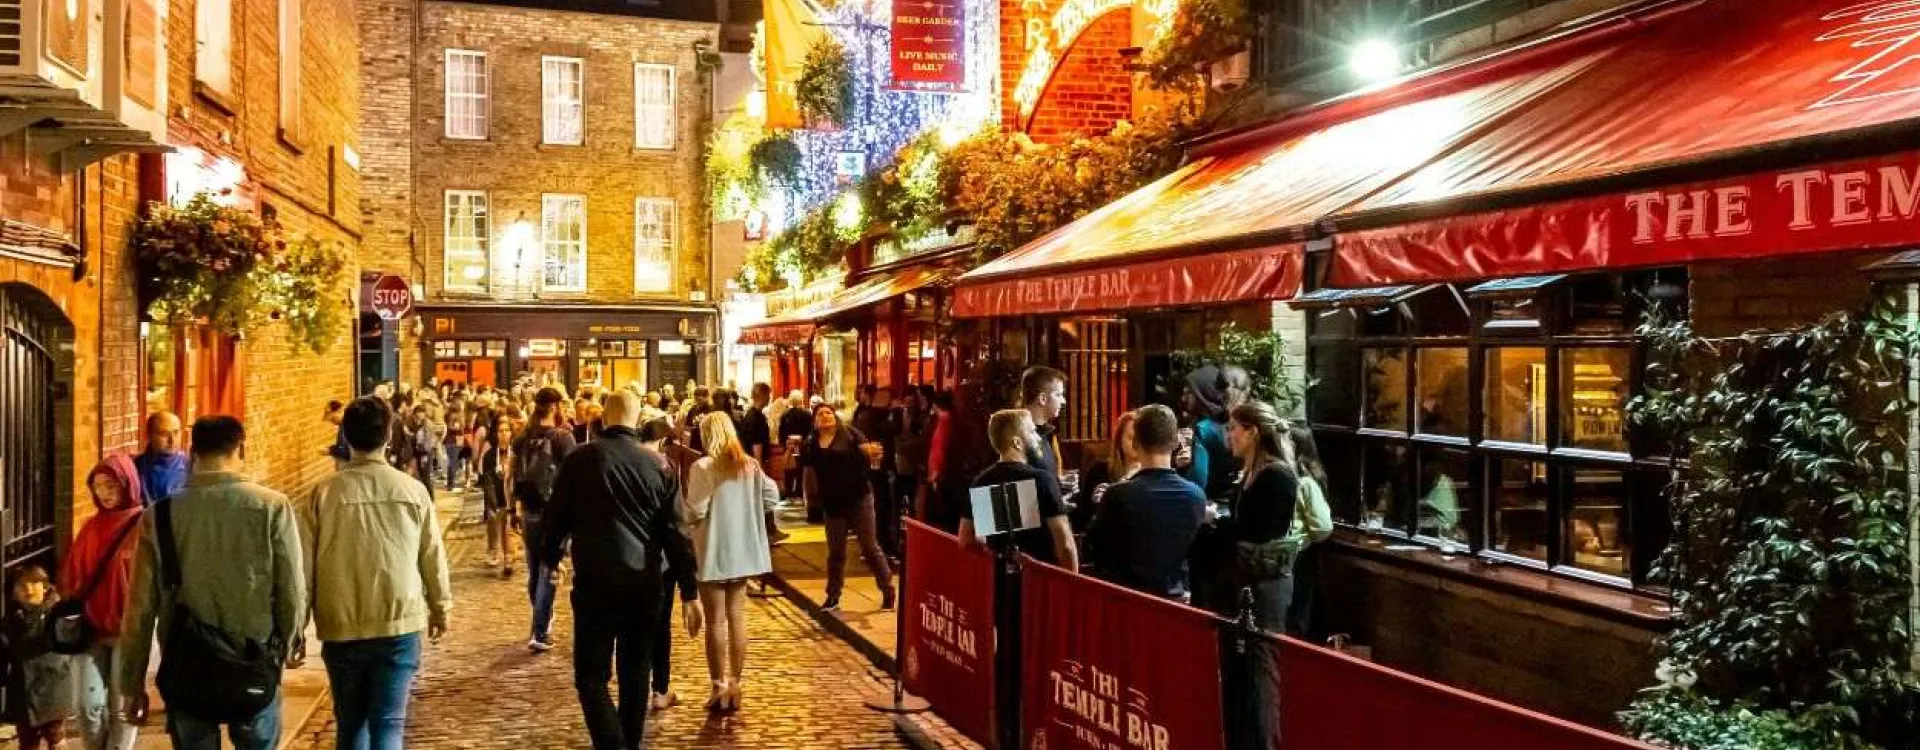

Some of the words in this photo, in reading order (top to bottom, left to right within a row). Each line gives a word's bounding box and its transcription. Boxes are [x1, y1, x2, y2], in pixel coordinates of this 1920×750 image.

[900, 51, 923, 60] LIVE
[924, 52, 958, 61] MUSIC
[912, 62, 944, 71] DAILY
[1625, 184, 1753, 245] THE
[1016, 279, 1043, 304] THE
[1046, 274, 1097, 302] TEMPLE
[1099, 268, 1131, 298] BAR
[374, 289, 408, 305] STOP
[435, 318, 456, 333] PI
[1126, 711, 1171, 750] BAR
